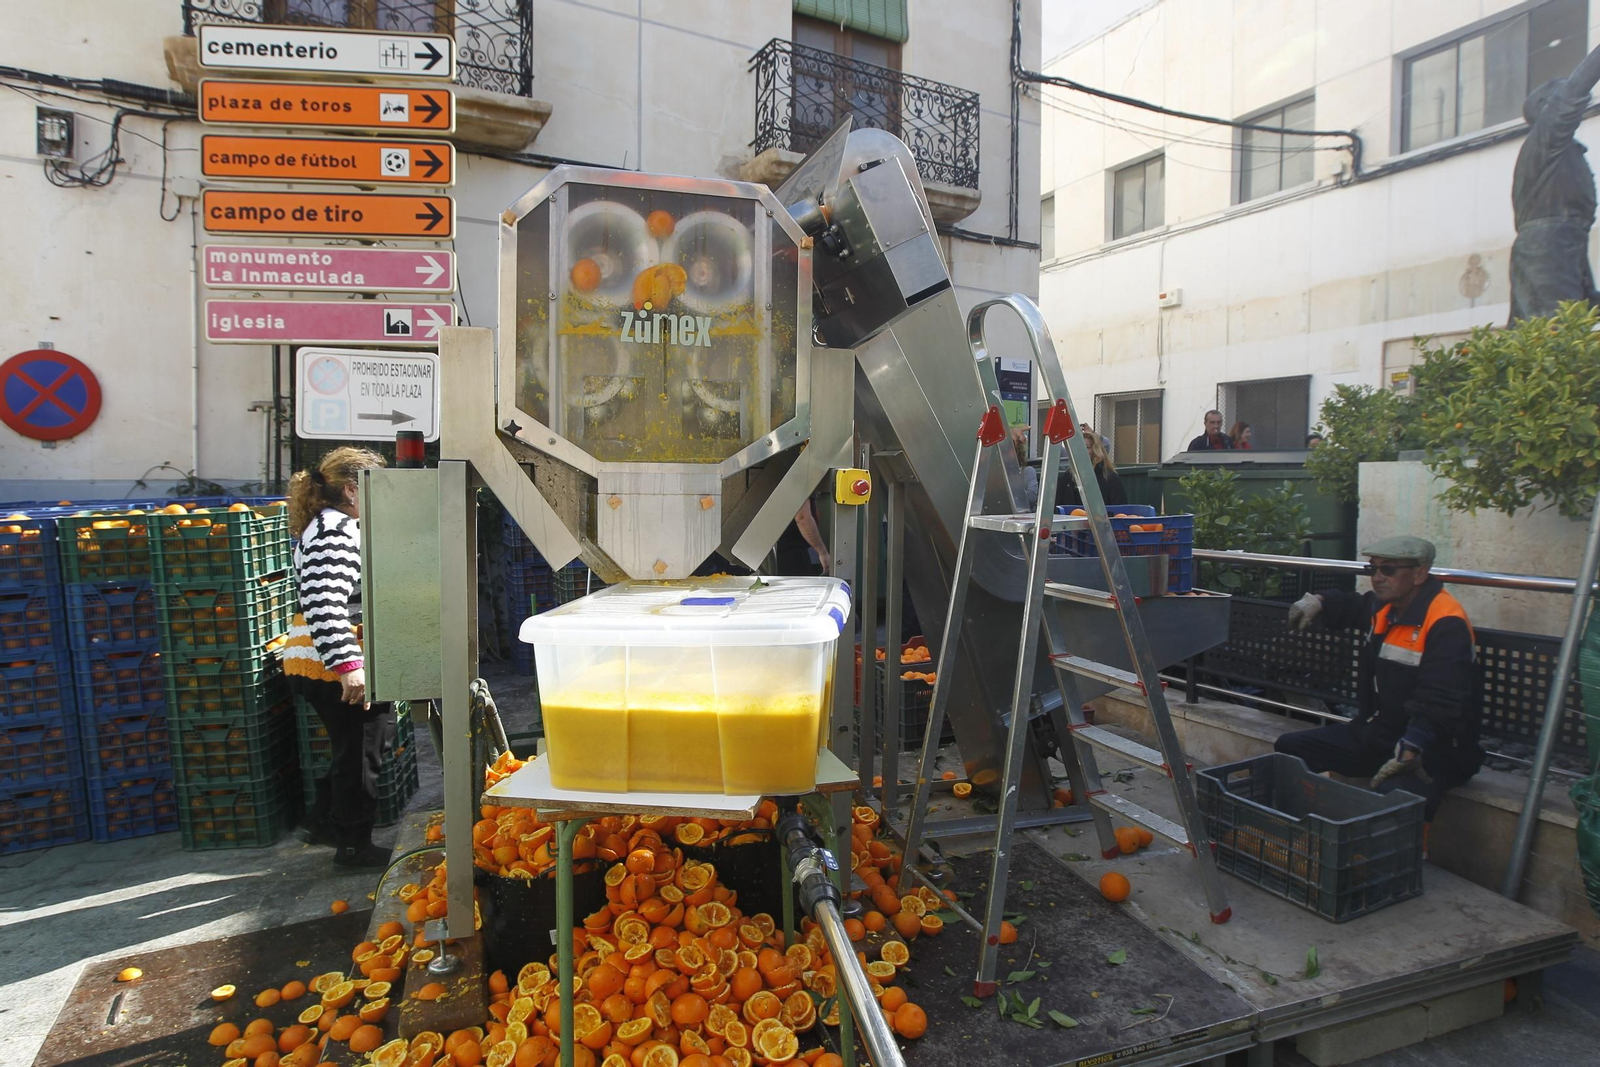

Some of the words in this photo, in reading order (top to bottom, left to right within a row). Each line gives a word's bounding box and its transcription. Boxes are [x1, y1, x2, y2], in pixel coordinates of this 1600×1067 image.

[207, 40, 338, 59] cementerio
[208, 95, 262, 110] plaza
[270, 96, 293, 110] de
[300, 99, 352, 112] toros
[209, 153, 270, 167] campo
[276, 152, 296, 166] de
[301, 152, 357, 168] fútbol
[210, 206, 285, 223] campo
[292, 205, 318, 221] de
[323, 206, 363, 222] tiro
[210, 252, 333, 266] monumento
[210, 268, 233, 282] La
[242, 269, 365, 285] Inmaculada
[212, 314, 285, 332] iglesia
[352, 362, 389, 376] PROHIBIDO
[391, 364, 431, 378] ESTACIONAR
[361, 382, 370, 396] EN
[372, 382, 390, 397] TODA
[391, 384, 400, 397] LA
[402, 384, 422, 398] PLAZA
